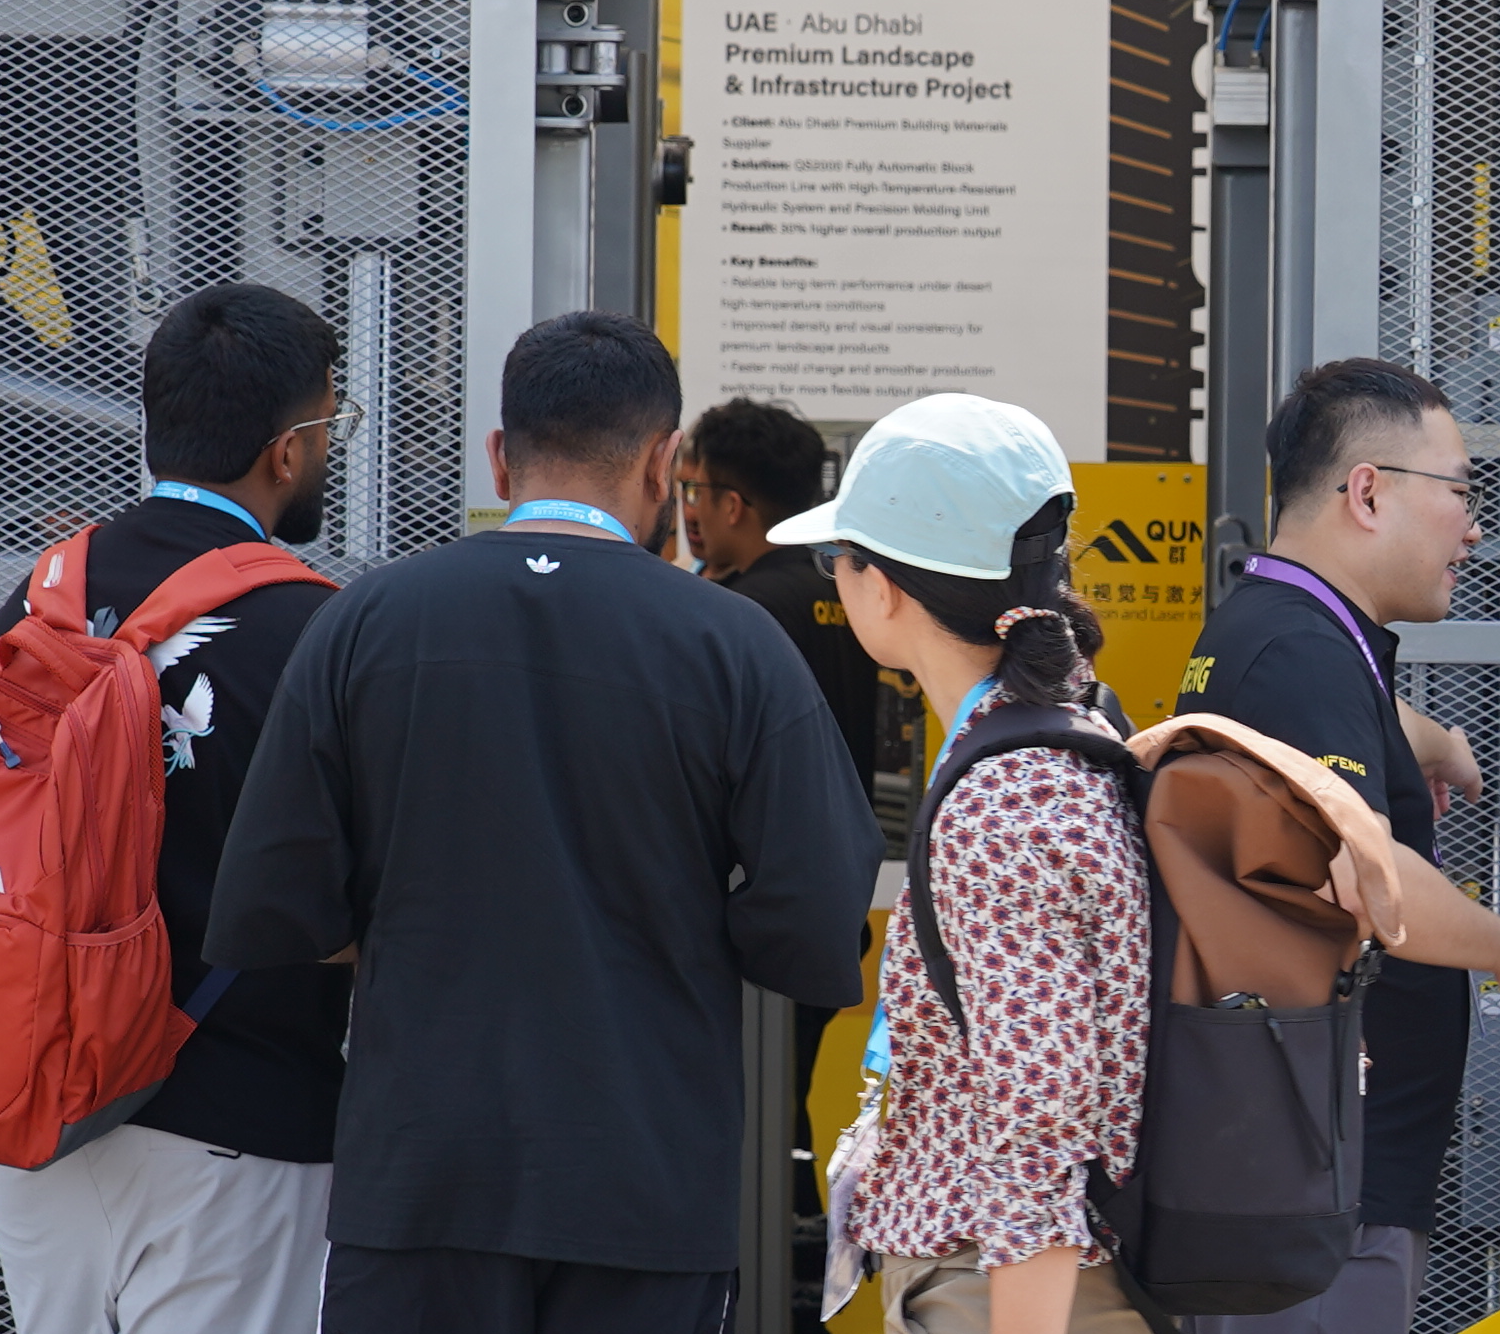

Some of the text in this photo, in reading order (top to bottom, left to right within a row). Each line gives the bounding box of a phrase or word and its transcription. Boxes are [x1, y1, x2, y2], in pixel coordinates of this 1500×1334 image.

[725, 12, 923, 36] UAE Abu Dhabi
[725, 43, 975, 72] Premium Landscape
[724, 74, 1012, 104] & Infrastructure Project
